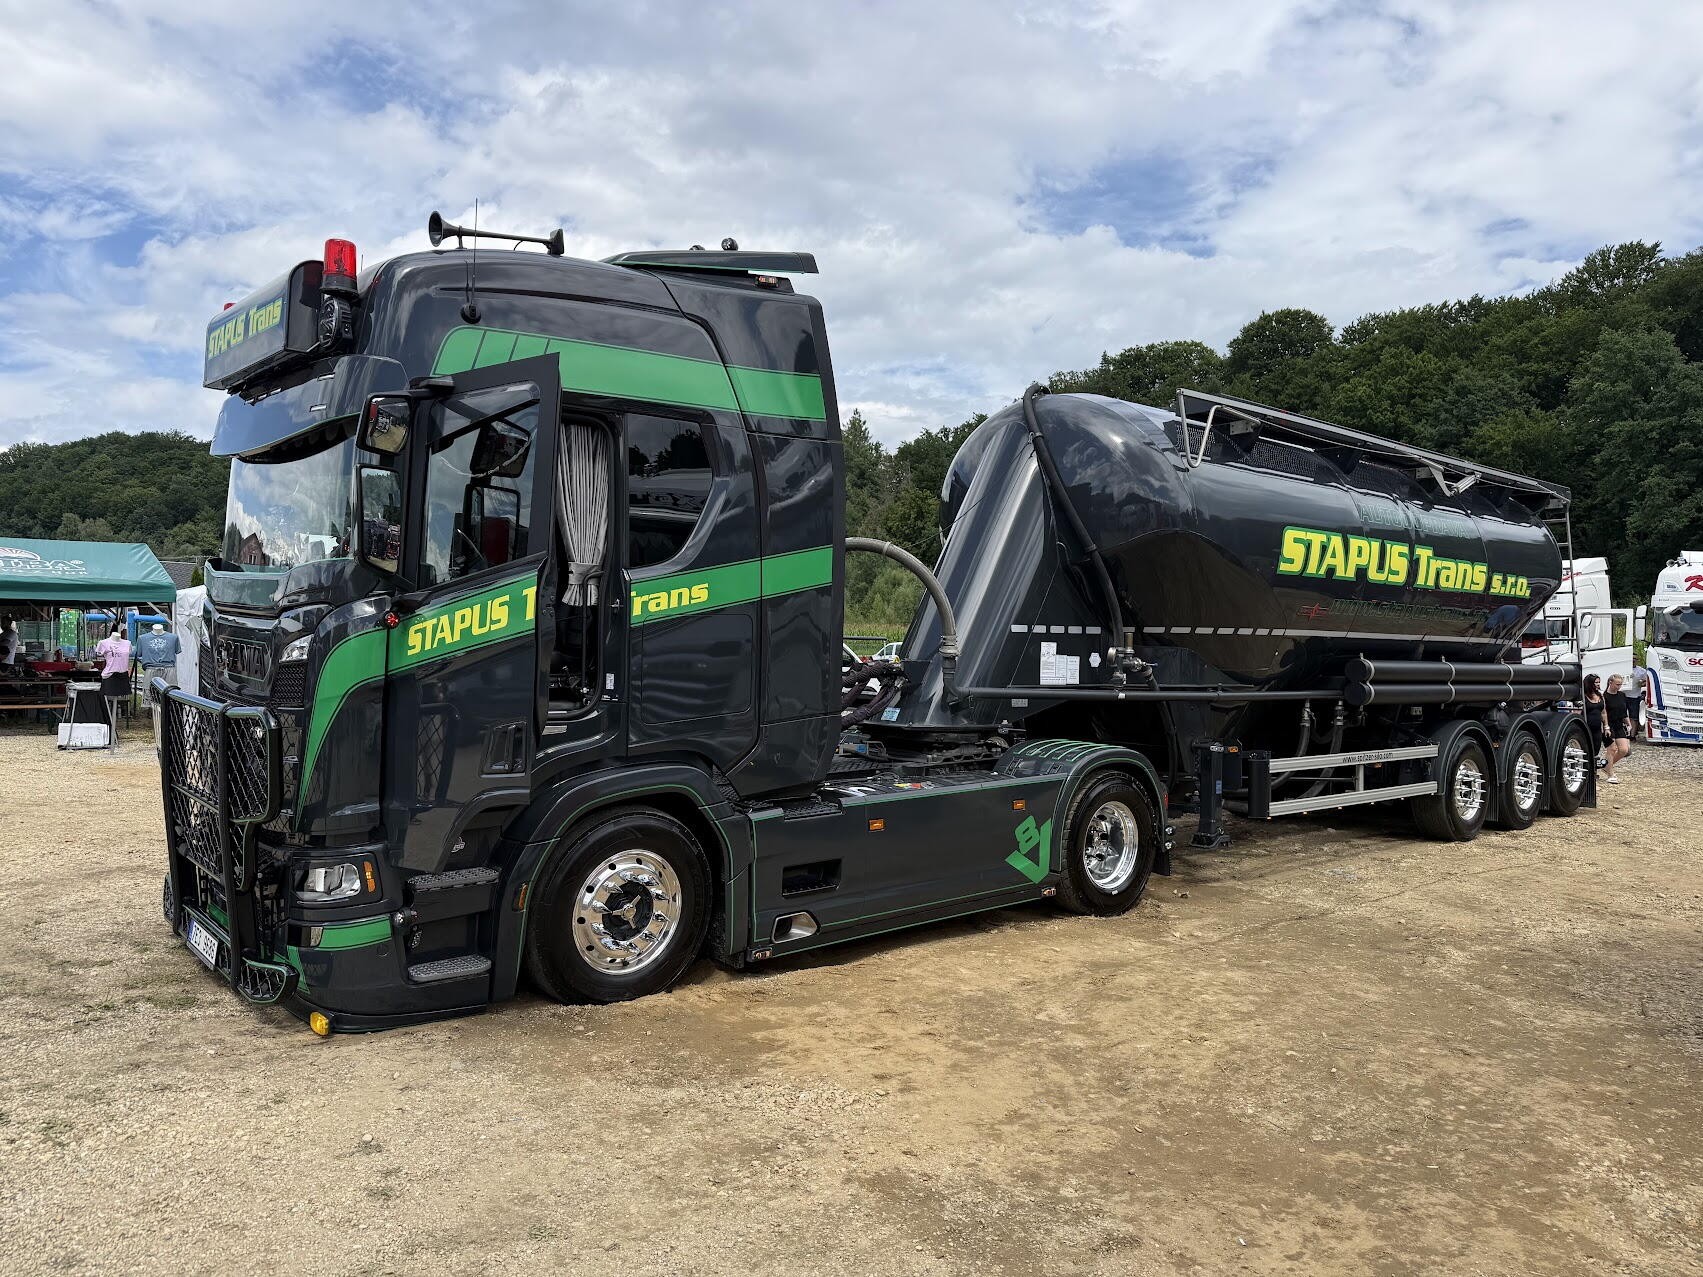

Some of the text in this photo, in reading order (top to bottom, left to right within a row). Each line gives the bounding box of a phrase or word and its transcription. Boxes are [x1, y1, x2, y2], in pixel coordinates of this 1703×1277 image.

[208, 297, 283, 360] STAPUS Trans
[1278, 527, 1531, 598] STAPUS Trans s.r.o.
[407, 595, 510, 656] STAPUS
[631, 583, 709, 616] rans
